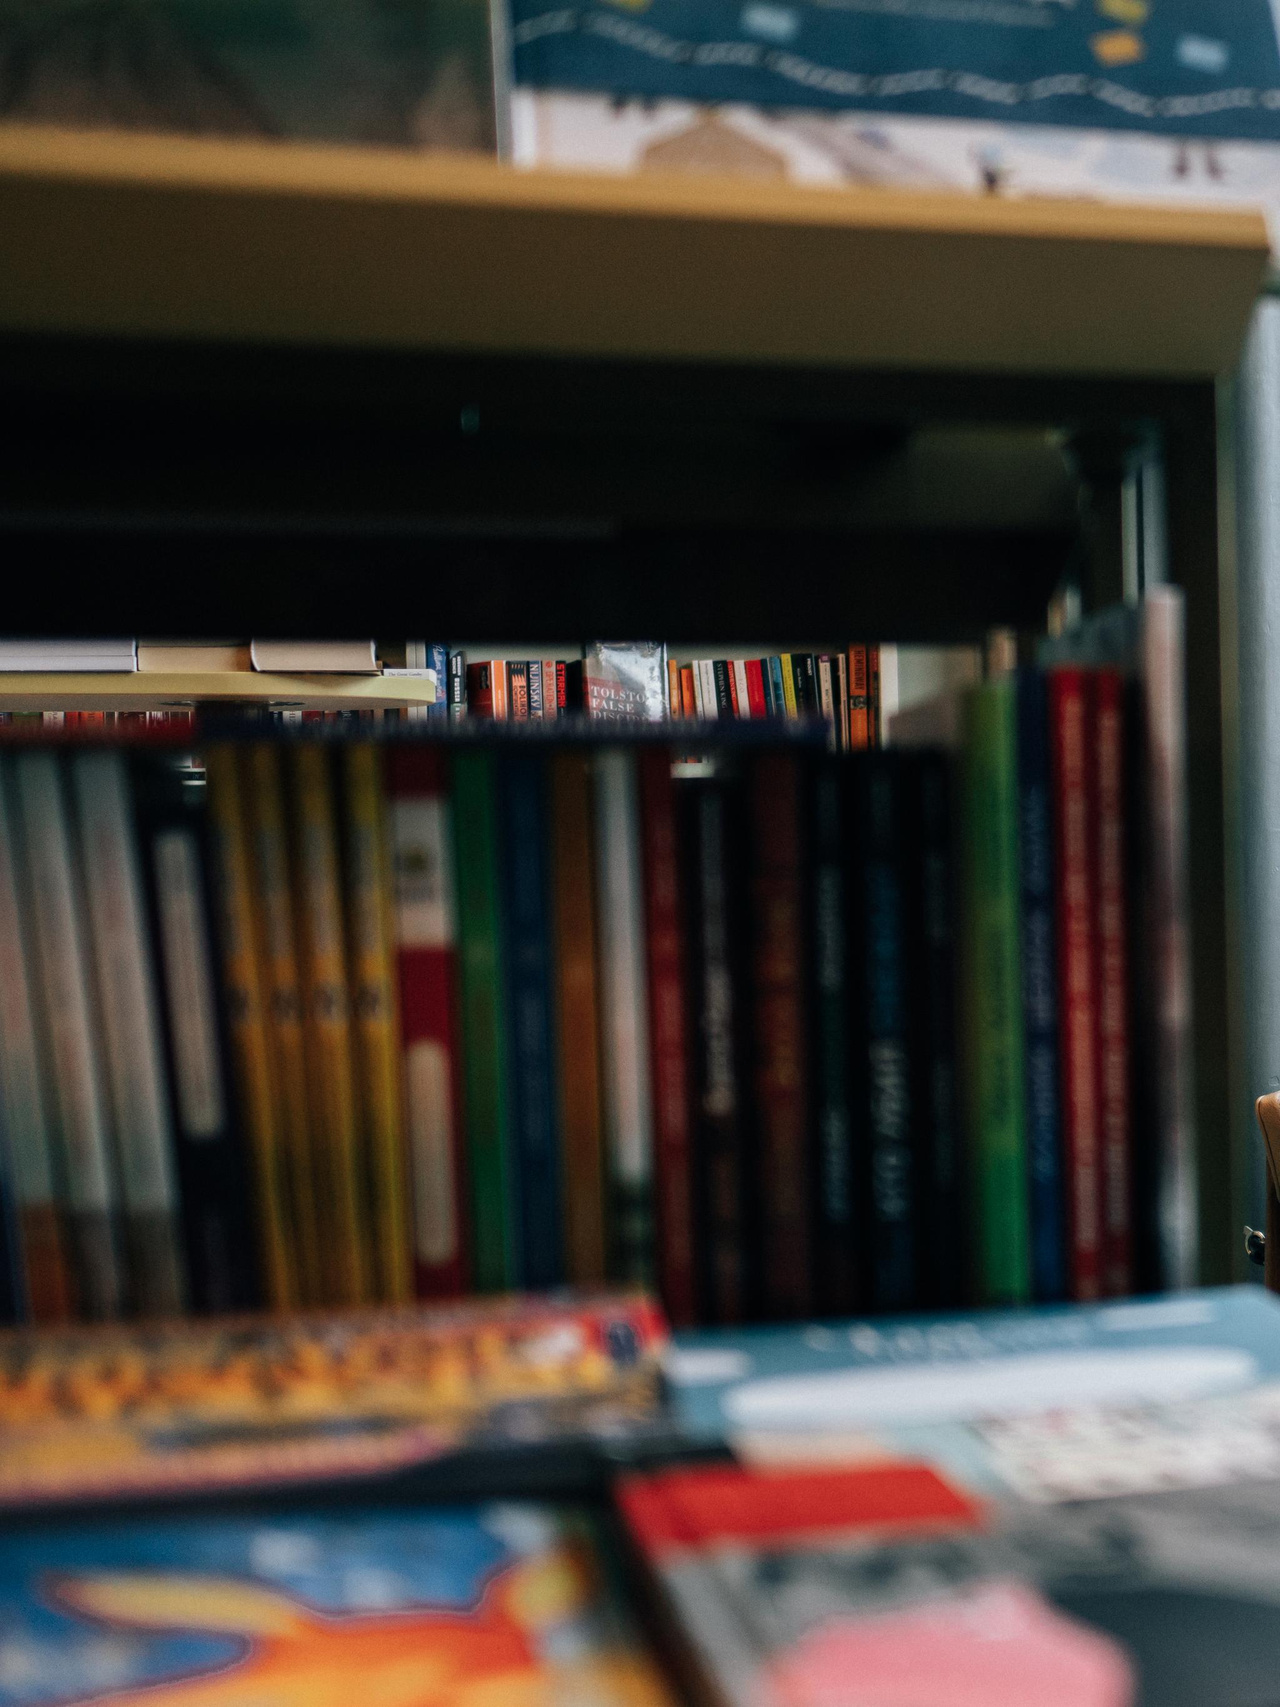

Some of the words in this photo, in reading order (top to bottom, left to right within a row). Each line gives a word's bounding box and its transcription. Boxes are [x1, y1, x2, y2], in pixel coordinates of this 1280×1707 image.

[530, 664, 541, 708] NIJINSKY
[556, 664, 566, 708] STARMAN
[717, 663, 725, 692] STEPHEN
[592, 698, 634, 712] FALSE
